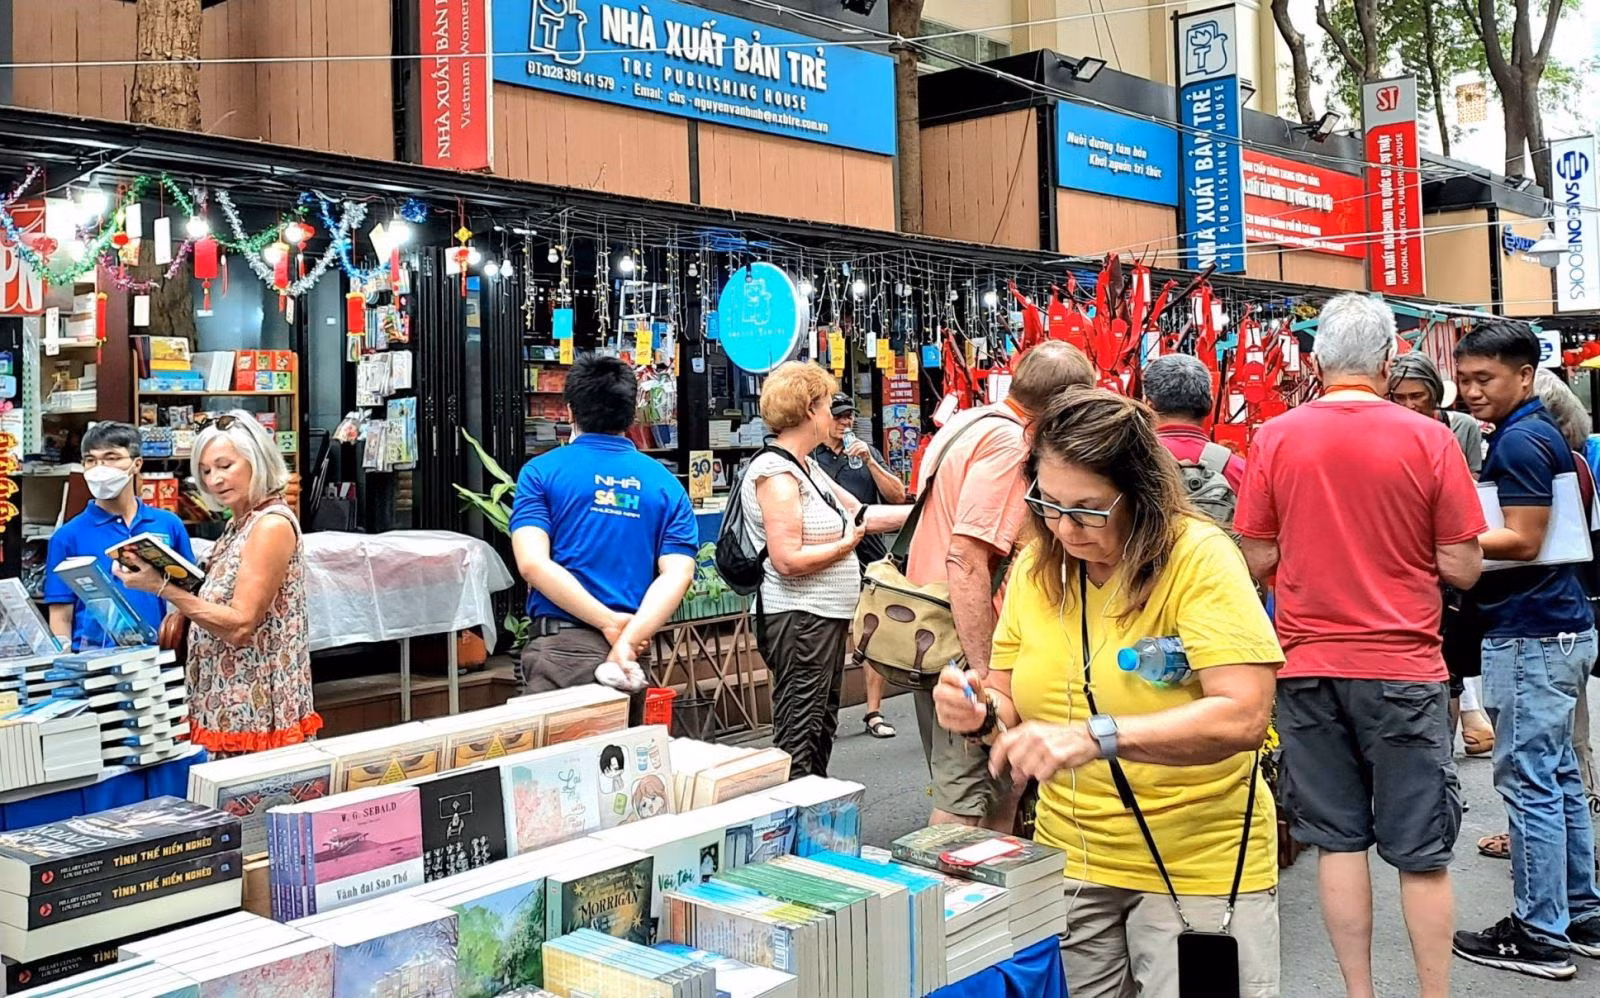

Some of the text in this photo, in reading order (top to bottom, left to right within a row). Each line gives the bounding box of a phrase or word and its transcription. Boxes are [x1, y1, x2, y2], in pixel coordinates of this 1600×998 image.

[602, 4, 828, 91] NHÀ XUẤT BẢN TRẺ
[432, 9, 451, 158] NHÀ XUẤT BẢN
[460, 61, 471, 128] Vietnam
[564, 68, 582, 84] 391
[583, 72, 596, 86] 41
[597, 75, 615, 90] 579
[634, 83, 664, 100] Email:
[621, 56, 807, 111] TRE PUBLISHING HOUSE
[1377, 87, 1399, 111] ST
[1186, 88, 1212, 126] TRẺ
[1215, 84, 1227, 130] HOUSE
[1189, 177, 1216, 224] XUẤT
[1216, 141, 1230, 232] PUBLISHING
[594, 474, 640, 490] NHÀ
[594, 488, 640, 510] SÁCH
[363, 801, 397, 818] SEBALD
[113, 853, 138, 867] TÌNH
[140, 845, 161, 863] THẾ
[112, 884, 137, 899] TÌNH
[139, 876, 160, 893] THẾ
[336, 887, 358, 900] Vành
[376, 879, 391, 891] Sao
[578, 890, 639, 919] MORRIGAN
